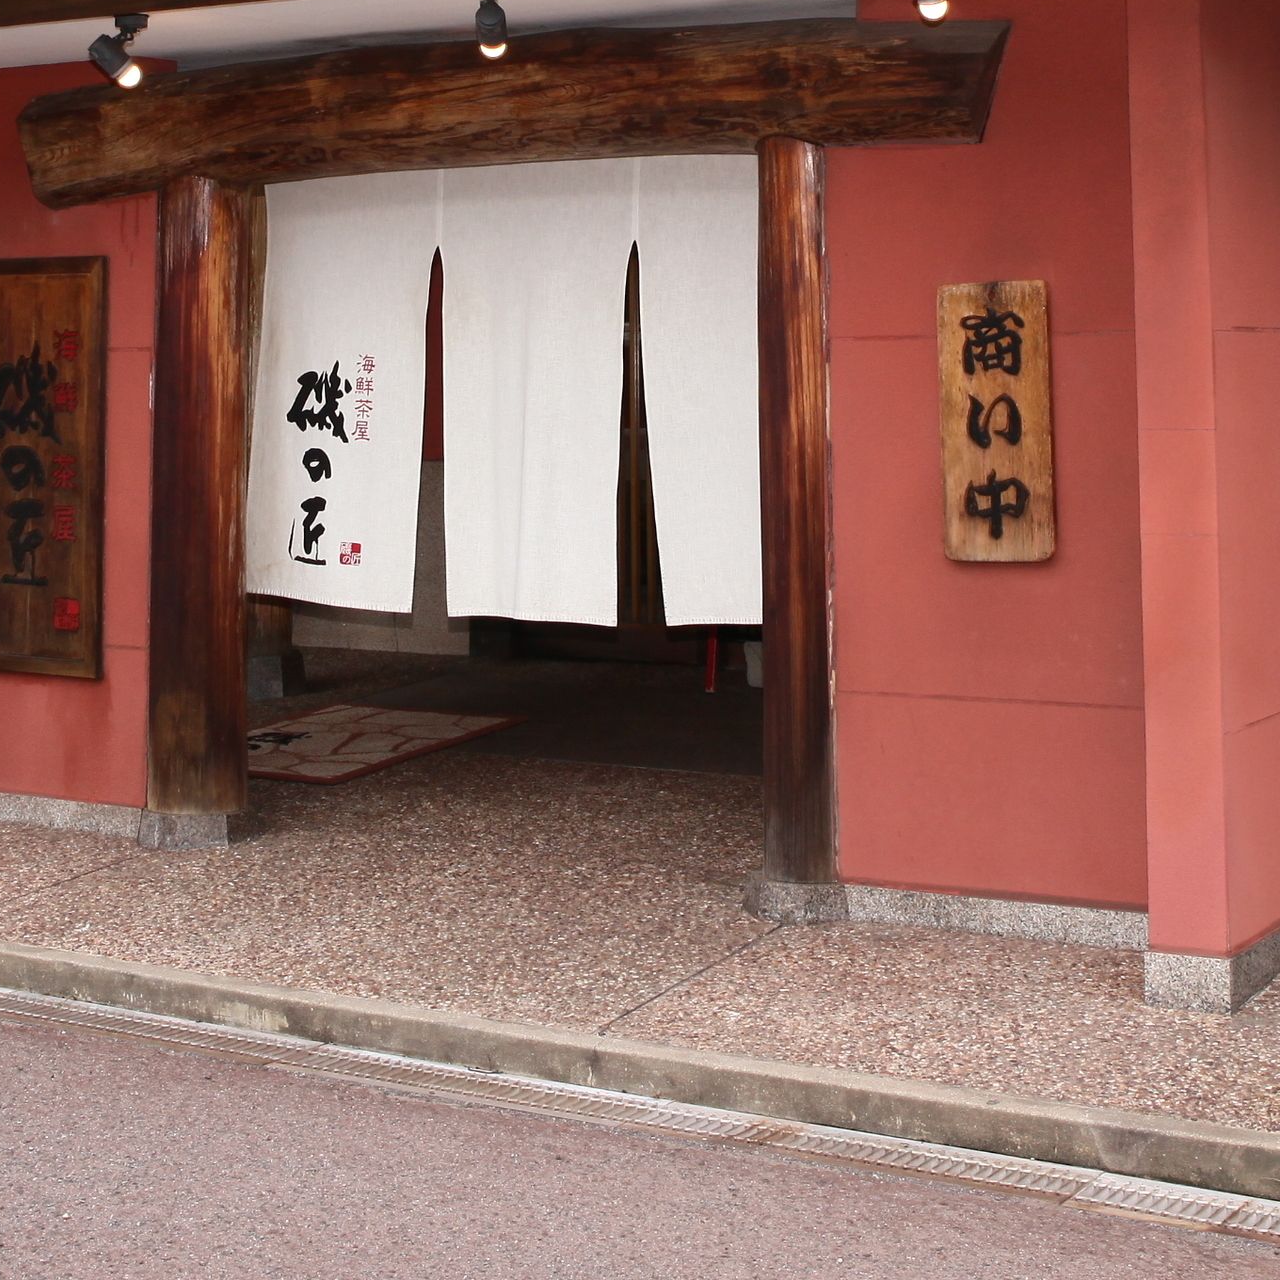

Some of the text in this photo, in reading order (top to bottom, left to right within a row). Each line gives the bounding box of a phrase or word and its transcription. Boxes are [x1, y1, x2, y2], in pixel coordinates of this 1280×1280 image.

[50, 329, 81, 543] 海鮮茶屋
[286, 360, 352, 566] 磯の匠
[351, 353, 376, 443] 海鮮茶屋
[960, 307, 1030, 540] 商い中
